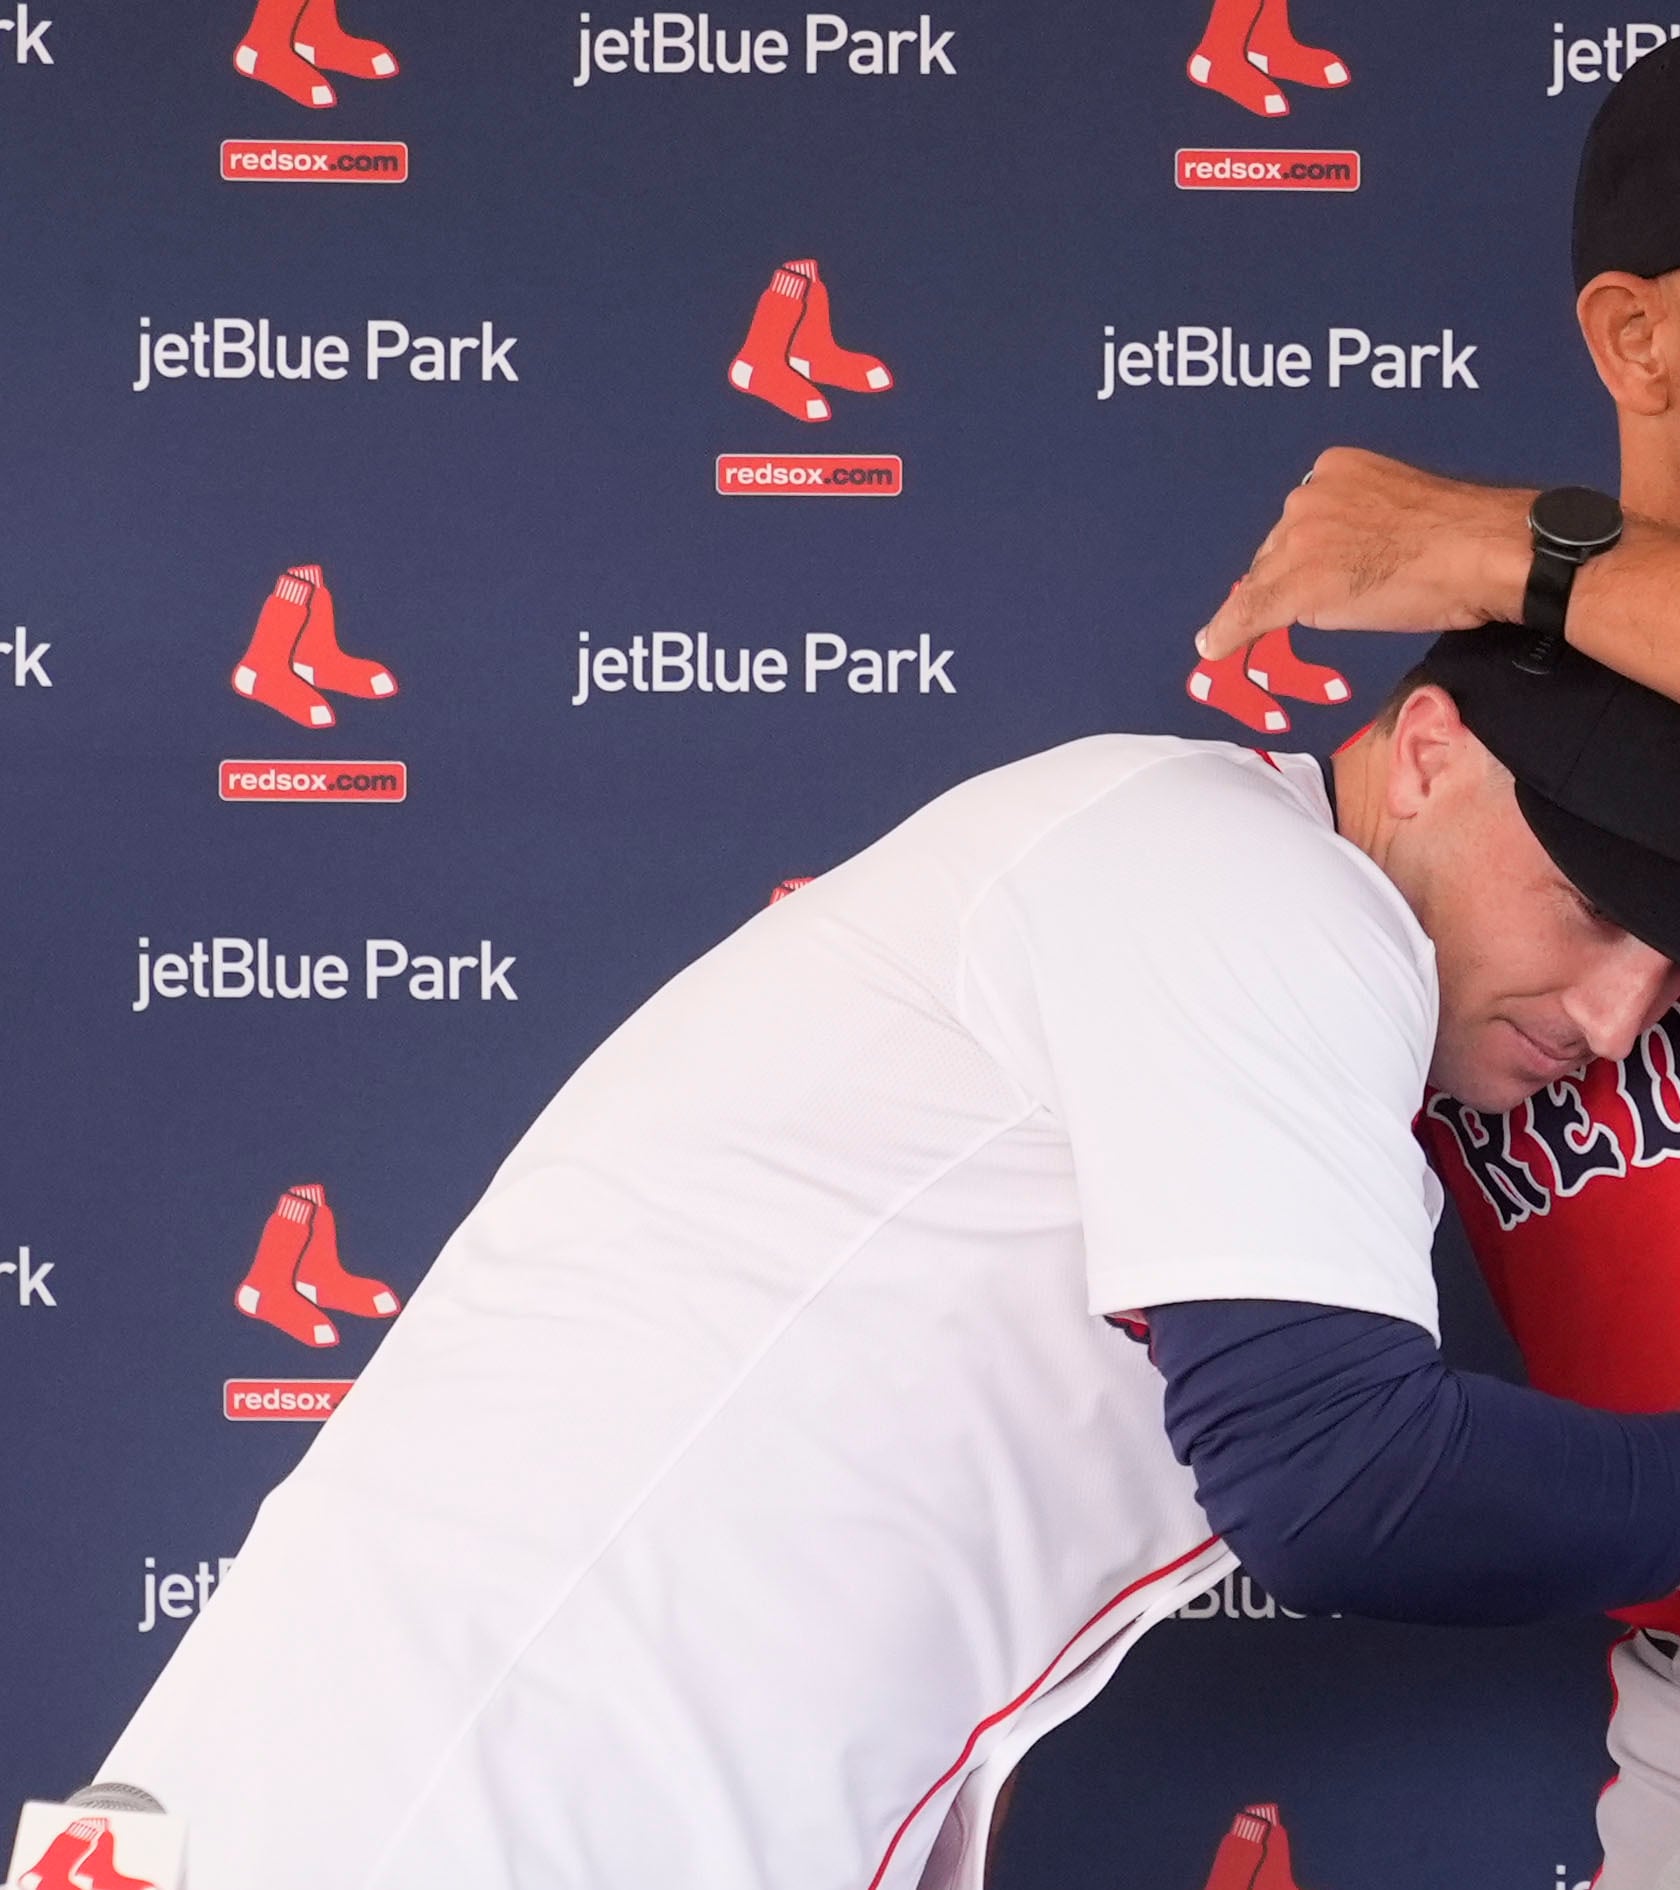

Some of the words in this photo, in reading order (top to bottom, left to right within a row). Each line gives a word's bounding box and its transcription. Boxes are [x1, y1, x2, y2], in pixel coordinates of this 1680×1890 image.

[573, 12, 789, 87] jetBlue
[805, 13, 957, 75] Park
[1546, 22, 1680, 97] jetB
[230, 148, 399, 171] redsox.com
[1185, 157, 1351, 179] redsox.com
[132, 316, 350, 392] jetBlue
[367, 319, 519, 382] Park
[1097, 325, 1312, 400] jetBlue
[1328, 327, 1479, 389] Park
[725, 462, 893, 485] redsox.com
[571, 631, 788, 706] jetBlue
[805, 632, 957, 694] Park
[229, 769, 397, 791] redsox.com
[132, 936, 349, 1012] jetBlue
[366, 939, 519, 1001] Park
